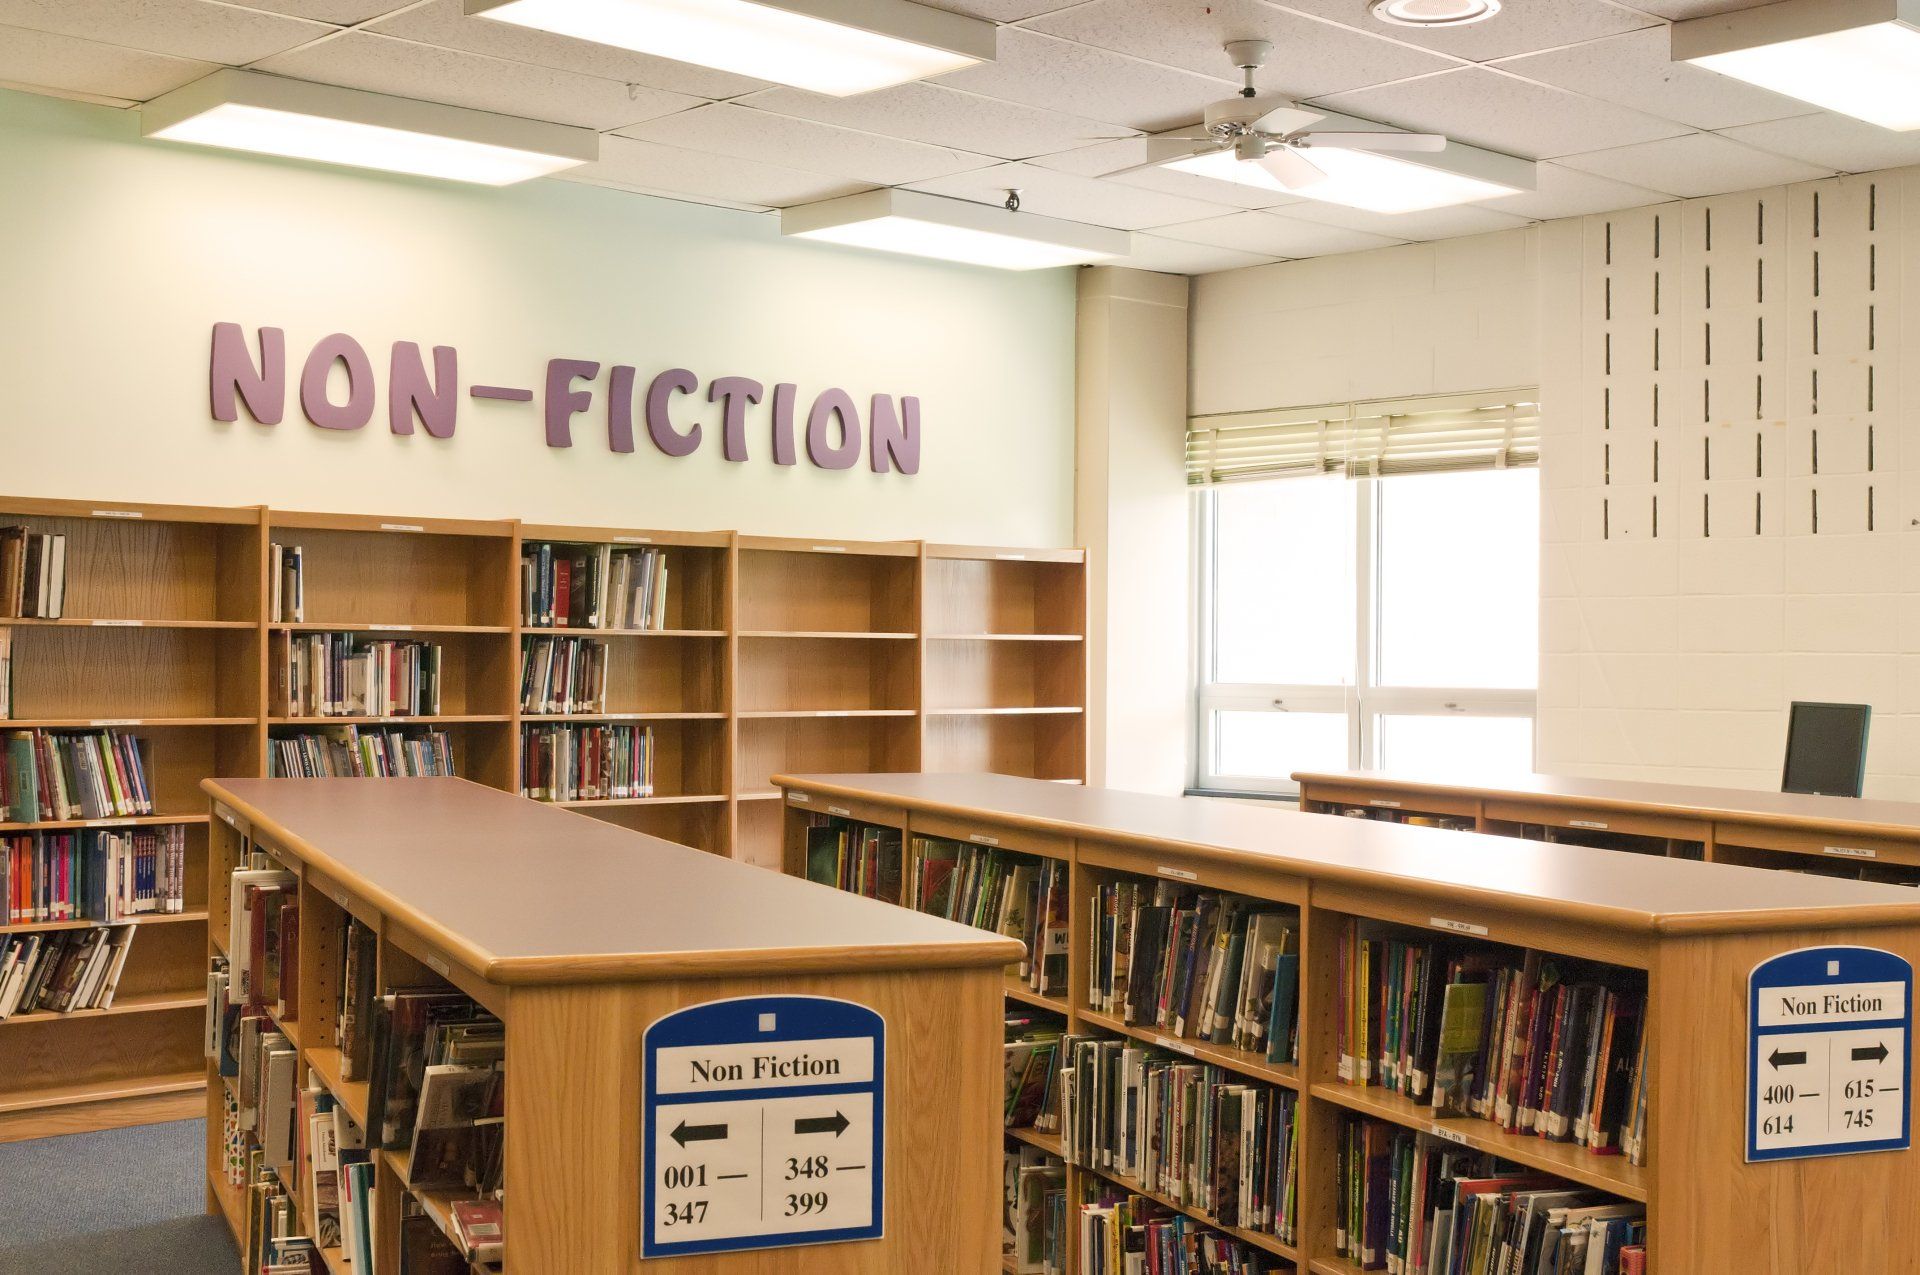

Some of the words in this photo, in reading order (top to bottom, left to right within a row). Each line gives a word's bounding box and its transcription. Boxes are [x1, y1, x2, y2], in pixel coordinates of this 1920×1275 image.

[210, 322, 920, 474] NON-FICTION
[1781, 997, 1817, 1016] Non
[1823, 994, 1882, 1014] Fiction
[690, 1059, 743, 1083] Non
[752, 1054, 841, 1079] Fiction
[1763, 1084, 1795, 1105] 400
[1844, 1078, 1874, 1099] 615
[1763, 1114, 1794, 1136] 614
[1844, 1108, 1874, 1129] 745
[664, 1163, 709, 1190] 001
[784, 1155, 829, 1181] 348
[663, 1200, 709, 1227] 347
[784, 1191, 829, 1217] 399
